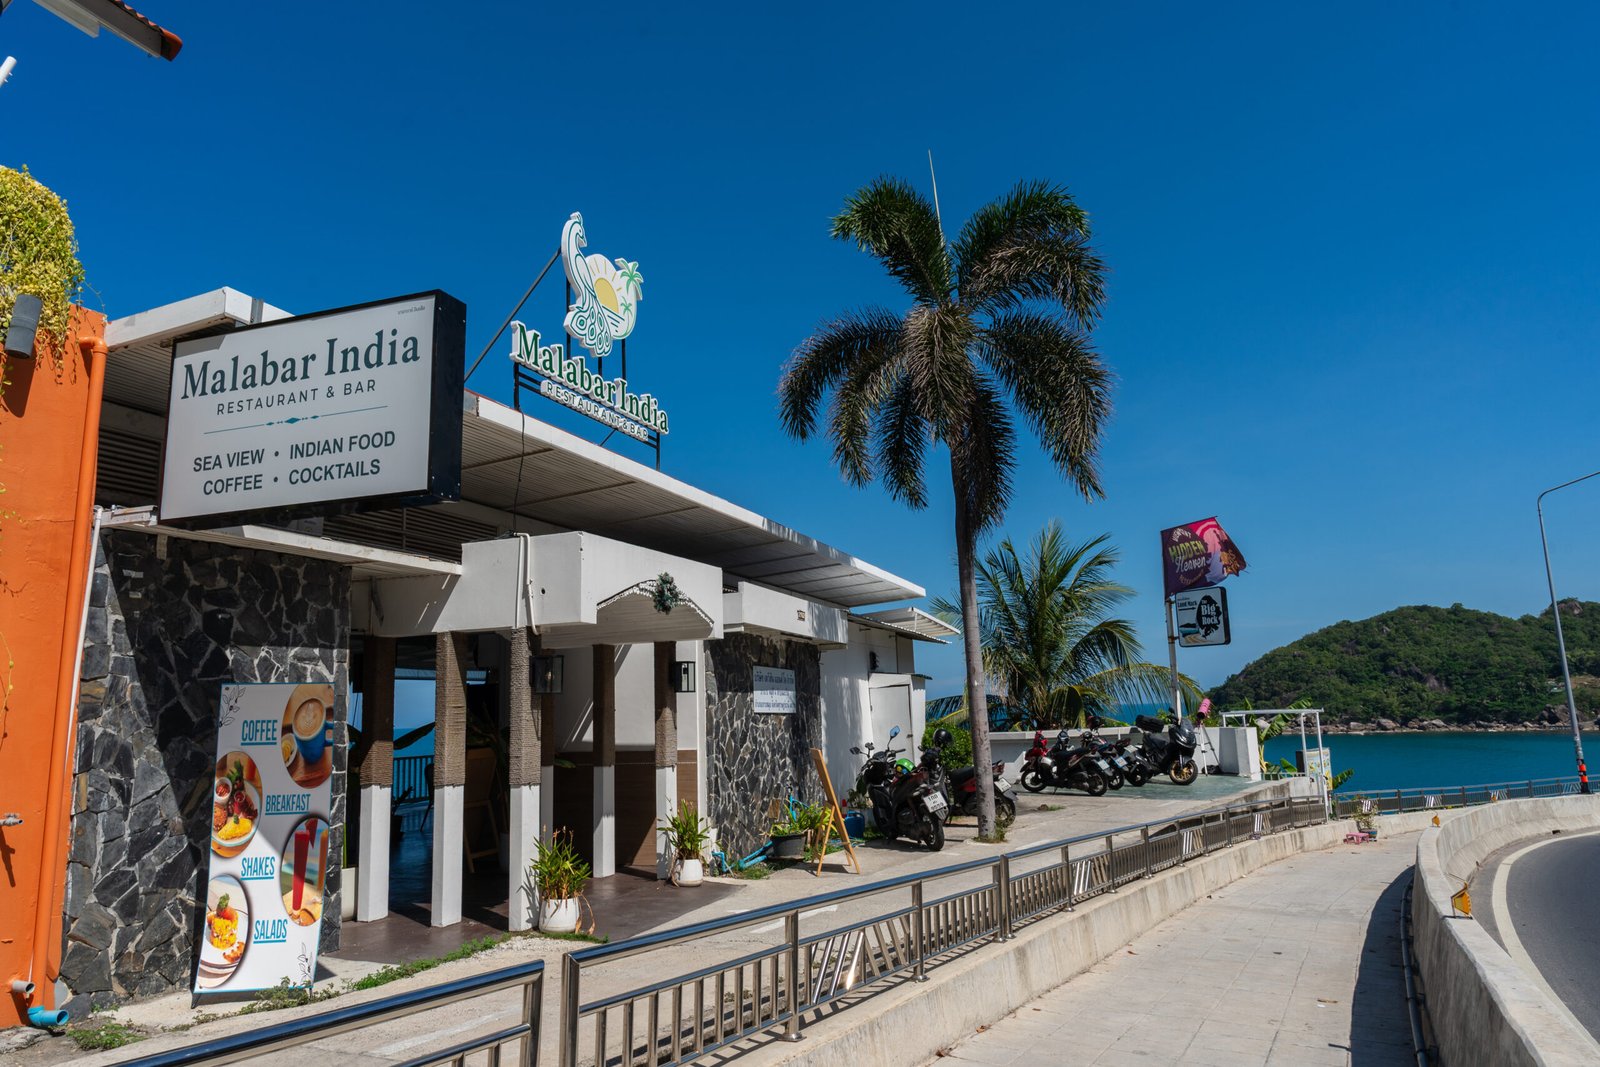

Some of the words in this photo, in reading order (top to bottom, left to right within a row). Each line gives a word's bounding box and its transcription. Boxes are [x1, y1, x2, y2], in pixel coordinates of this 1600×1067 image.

[181, 349, 317, 400] Malabar
[324, 328, 421, 377] India
[511, 321, 616, 405] Malabar
[615, 378, 669, 434] India
[216, 388, 319, 415] RESTAURANT
[326, 385, 335, 398] &
[343, 379, 376, 396] BAR
[546, 381, 620, 427] RESTAURANT
[630, 424, 649, 441] BAR
[193, 455, 223, 473] SEA
[227, 448, 265, 468] VIEW
[289, 437, 343, 460] INDIAN
[348, 430, 396, 452] FOOD
[203, 474, 263, 495] COFFEE
[288, 459, 381, 485] COCKTAILS
[1168, 540, 1206, 562] HIDDEN
[1201, 603, 1217, 616] Big
[1201, 616, 1219, 625] Rock
[241, 719, 278, 742] COFFEE
[265, 793, 311, 812] BREAKFAST
[241, 856, 276, 877] SHAKES
[254, 919, 288, 940] SALADS
